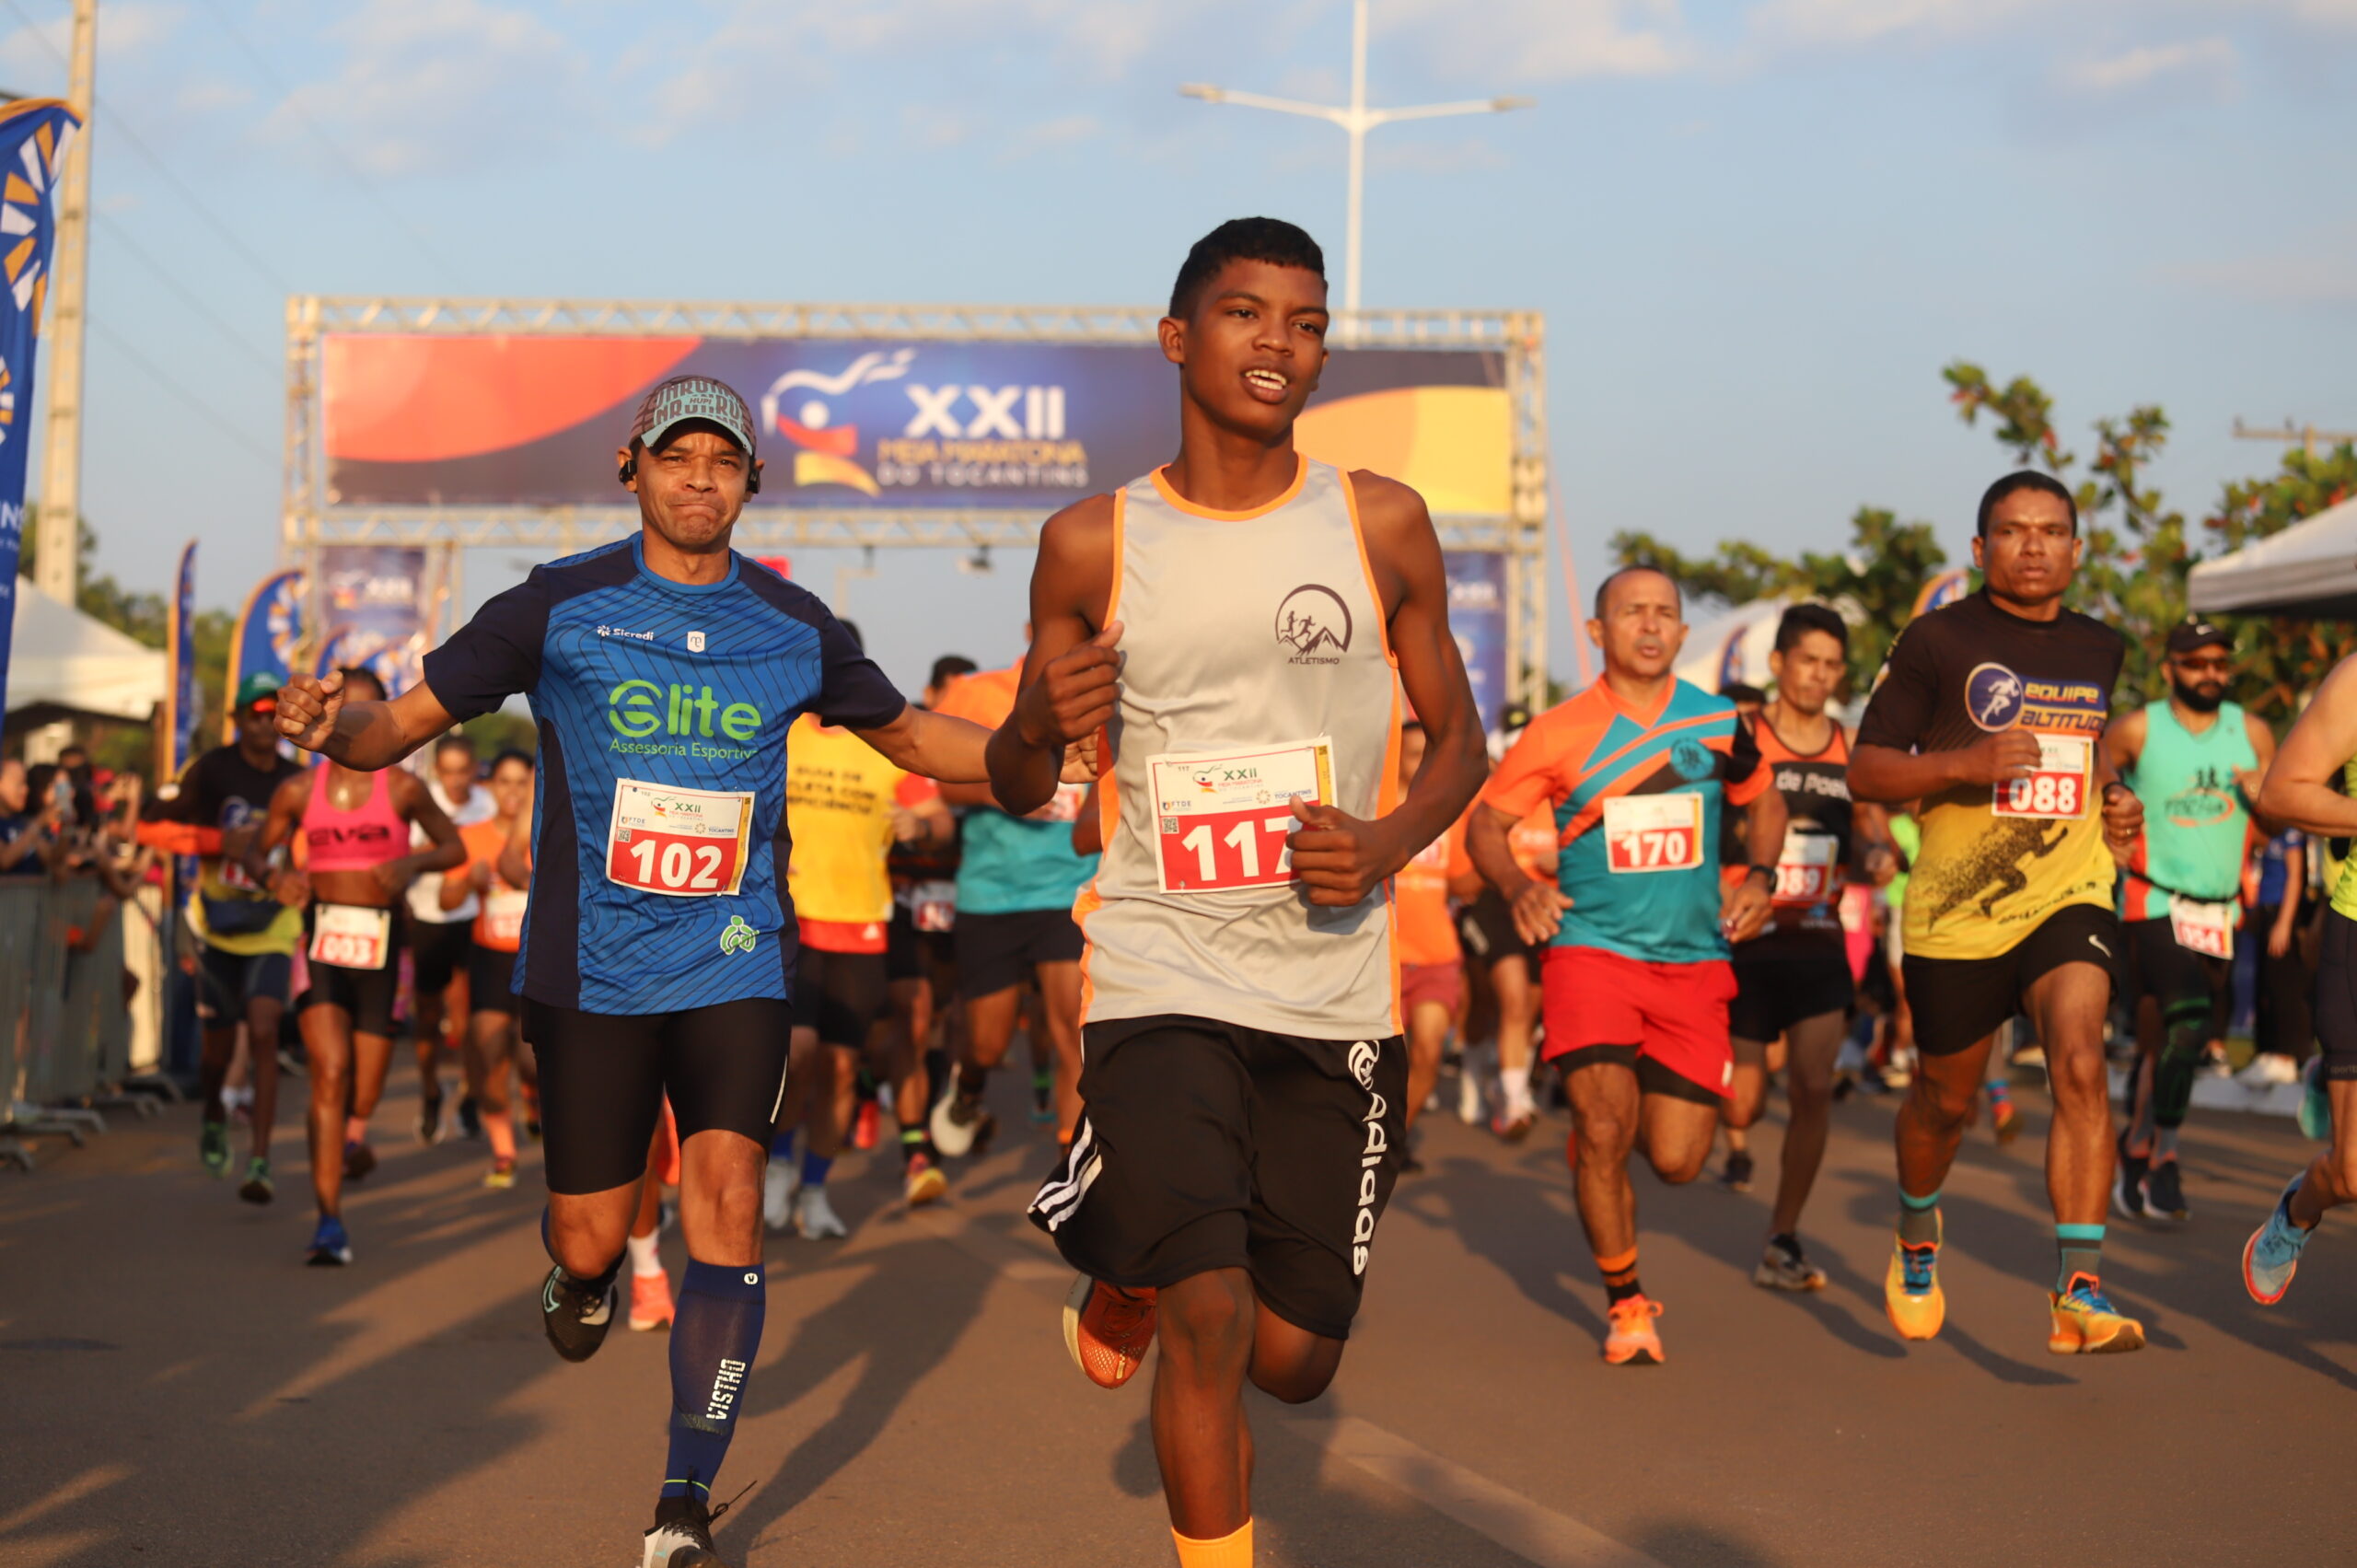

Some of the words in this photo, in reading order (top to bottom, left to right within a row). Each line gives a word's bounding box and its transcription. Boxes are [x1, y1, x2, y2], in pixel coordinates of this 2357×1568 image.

[903, 384, 1065, 439] XXII
[877, 463, 920, 486] DO
[930, 463, 1089, 488] TOCANTINS
[613, 628, 654, 641] Sicredi
[1288, 656, 1340, 665] ATLETISMO
[609, 679, 761, 740] Elite
[609, 738, 687, 756] Assessoria
[1224, 767, 1258, 782] XXII
[675, 802, 701, 813] XXII
[2008, 776, 2076, 814] 088
[1181, 815, 1300, 881] 117
[1621, 830, 1687, 866] 170
[630, 839, 722, 889] 102
